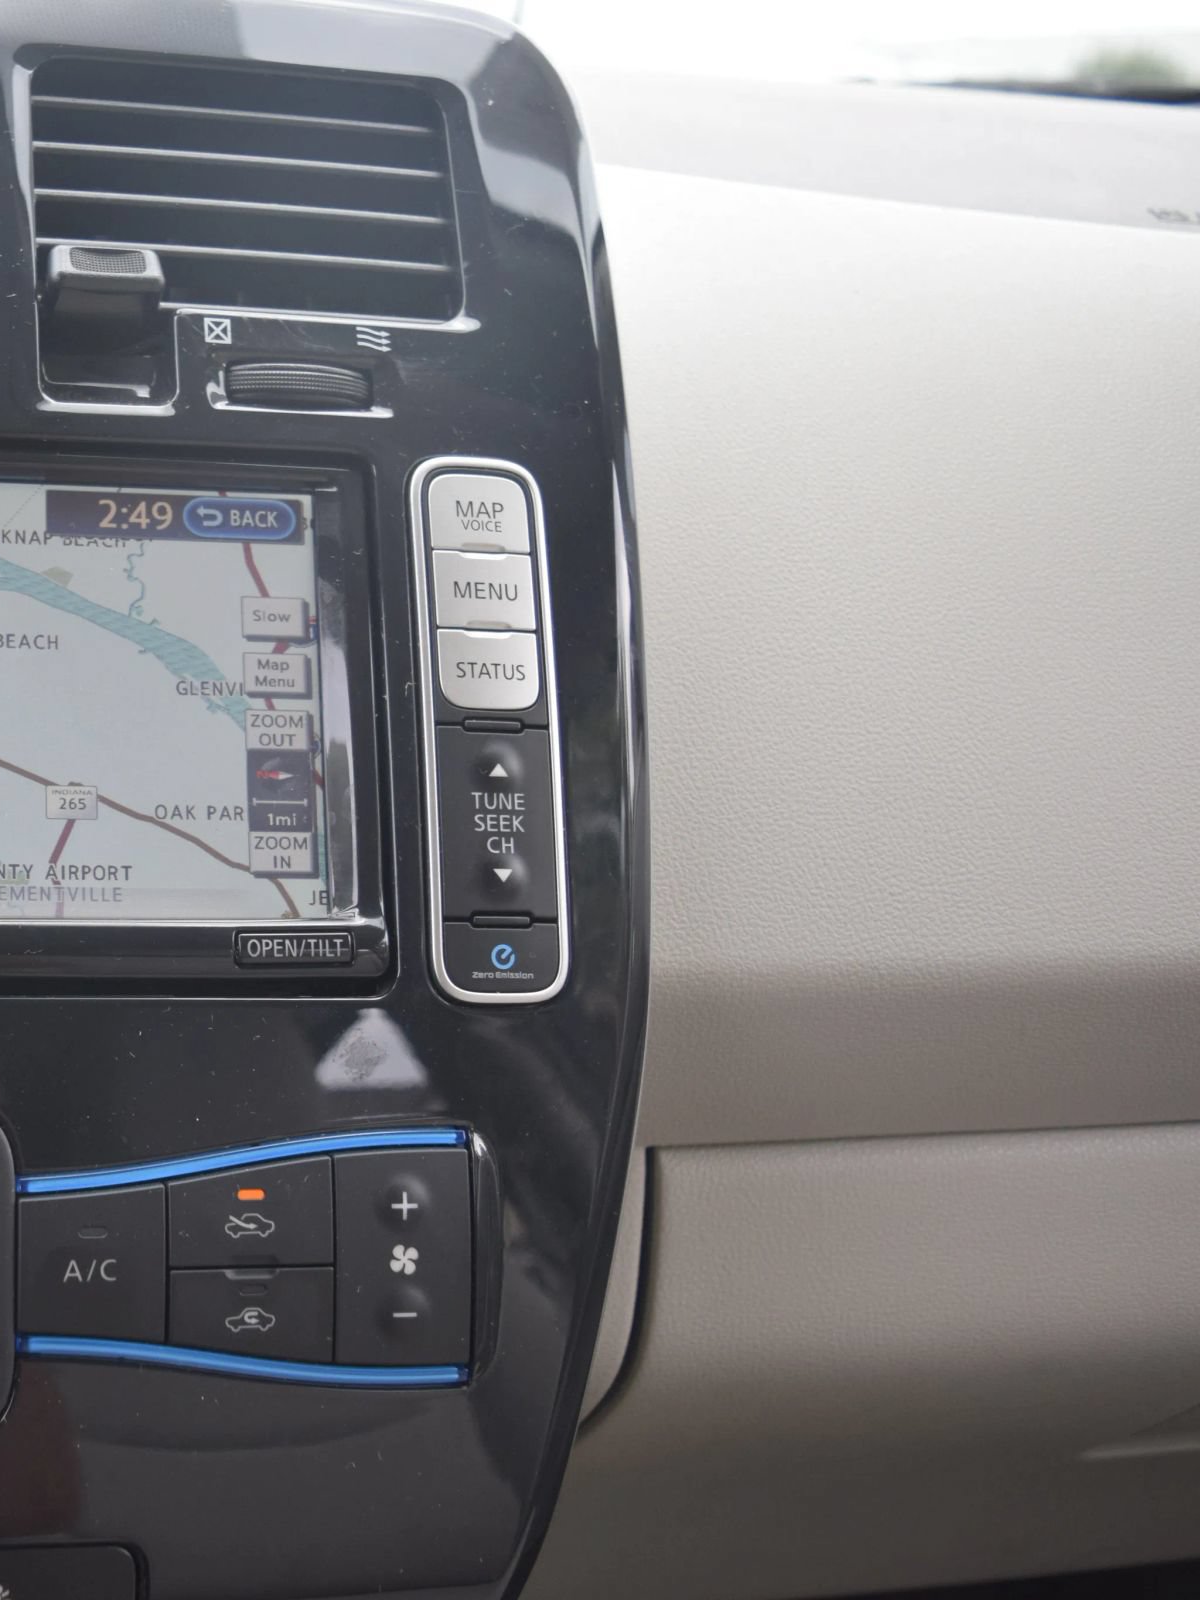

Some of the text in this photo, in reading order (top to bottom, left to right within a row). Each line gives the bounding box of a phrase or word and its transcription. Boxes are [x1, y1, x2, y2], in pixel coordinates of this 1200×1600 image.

[98, 499, 173, 530] 2:49
[455, 500, 504, 519] MAP
[230, 510, 278, 528] BACK
[461, 519, 502, 532] VOICE
[453, 581, 518, 601] MENU
[252, 609, 291, 623] Slow
[257, 658, 290, 673] Map
[456, 661, 526, 681] STATUS
[255, 675, 295, 688] Menu
[250, 714, 303, 728] ZOOM
[259, 733, 296, 747] OUT
[59, 797, 87, 810] 265
[472, 792, 525, 811] TUNE
[154, 804, 196, 820] OAK
[474, 815, 525, 834] SEEK
[253, 836, 308, 850] ZOOM
[487, 837, 514, 855] CH
[273, 855, 291, 869] IN
[45, 864, 133, 881] AIRPORT
[247, 939, 344, 957] OPEN/TILT
[472, 971, 535, 980] Zero Emission
[63, 1259, 118, 1283] A/C
